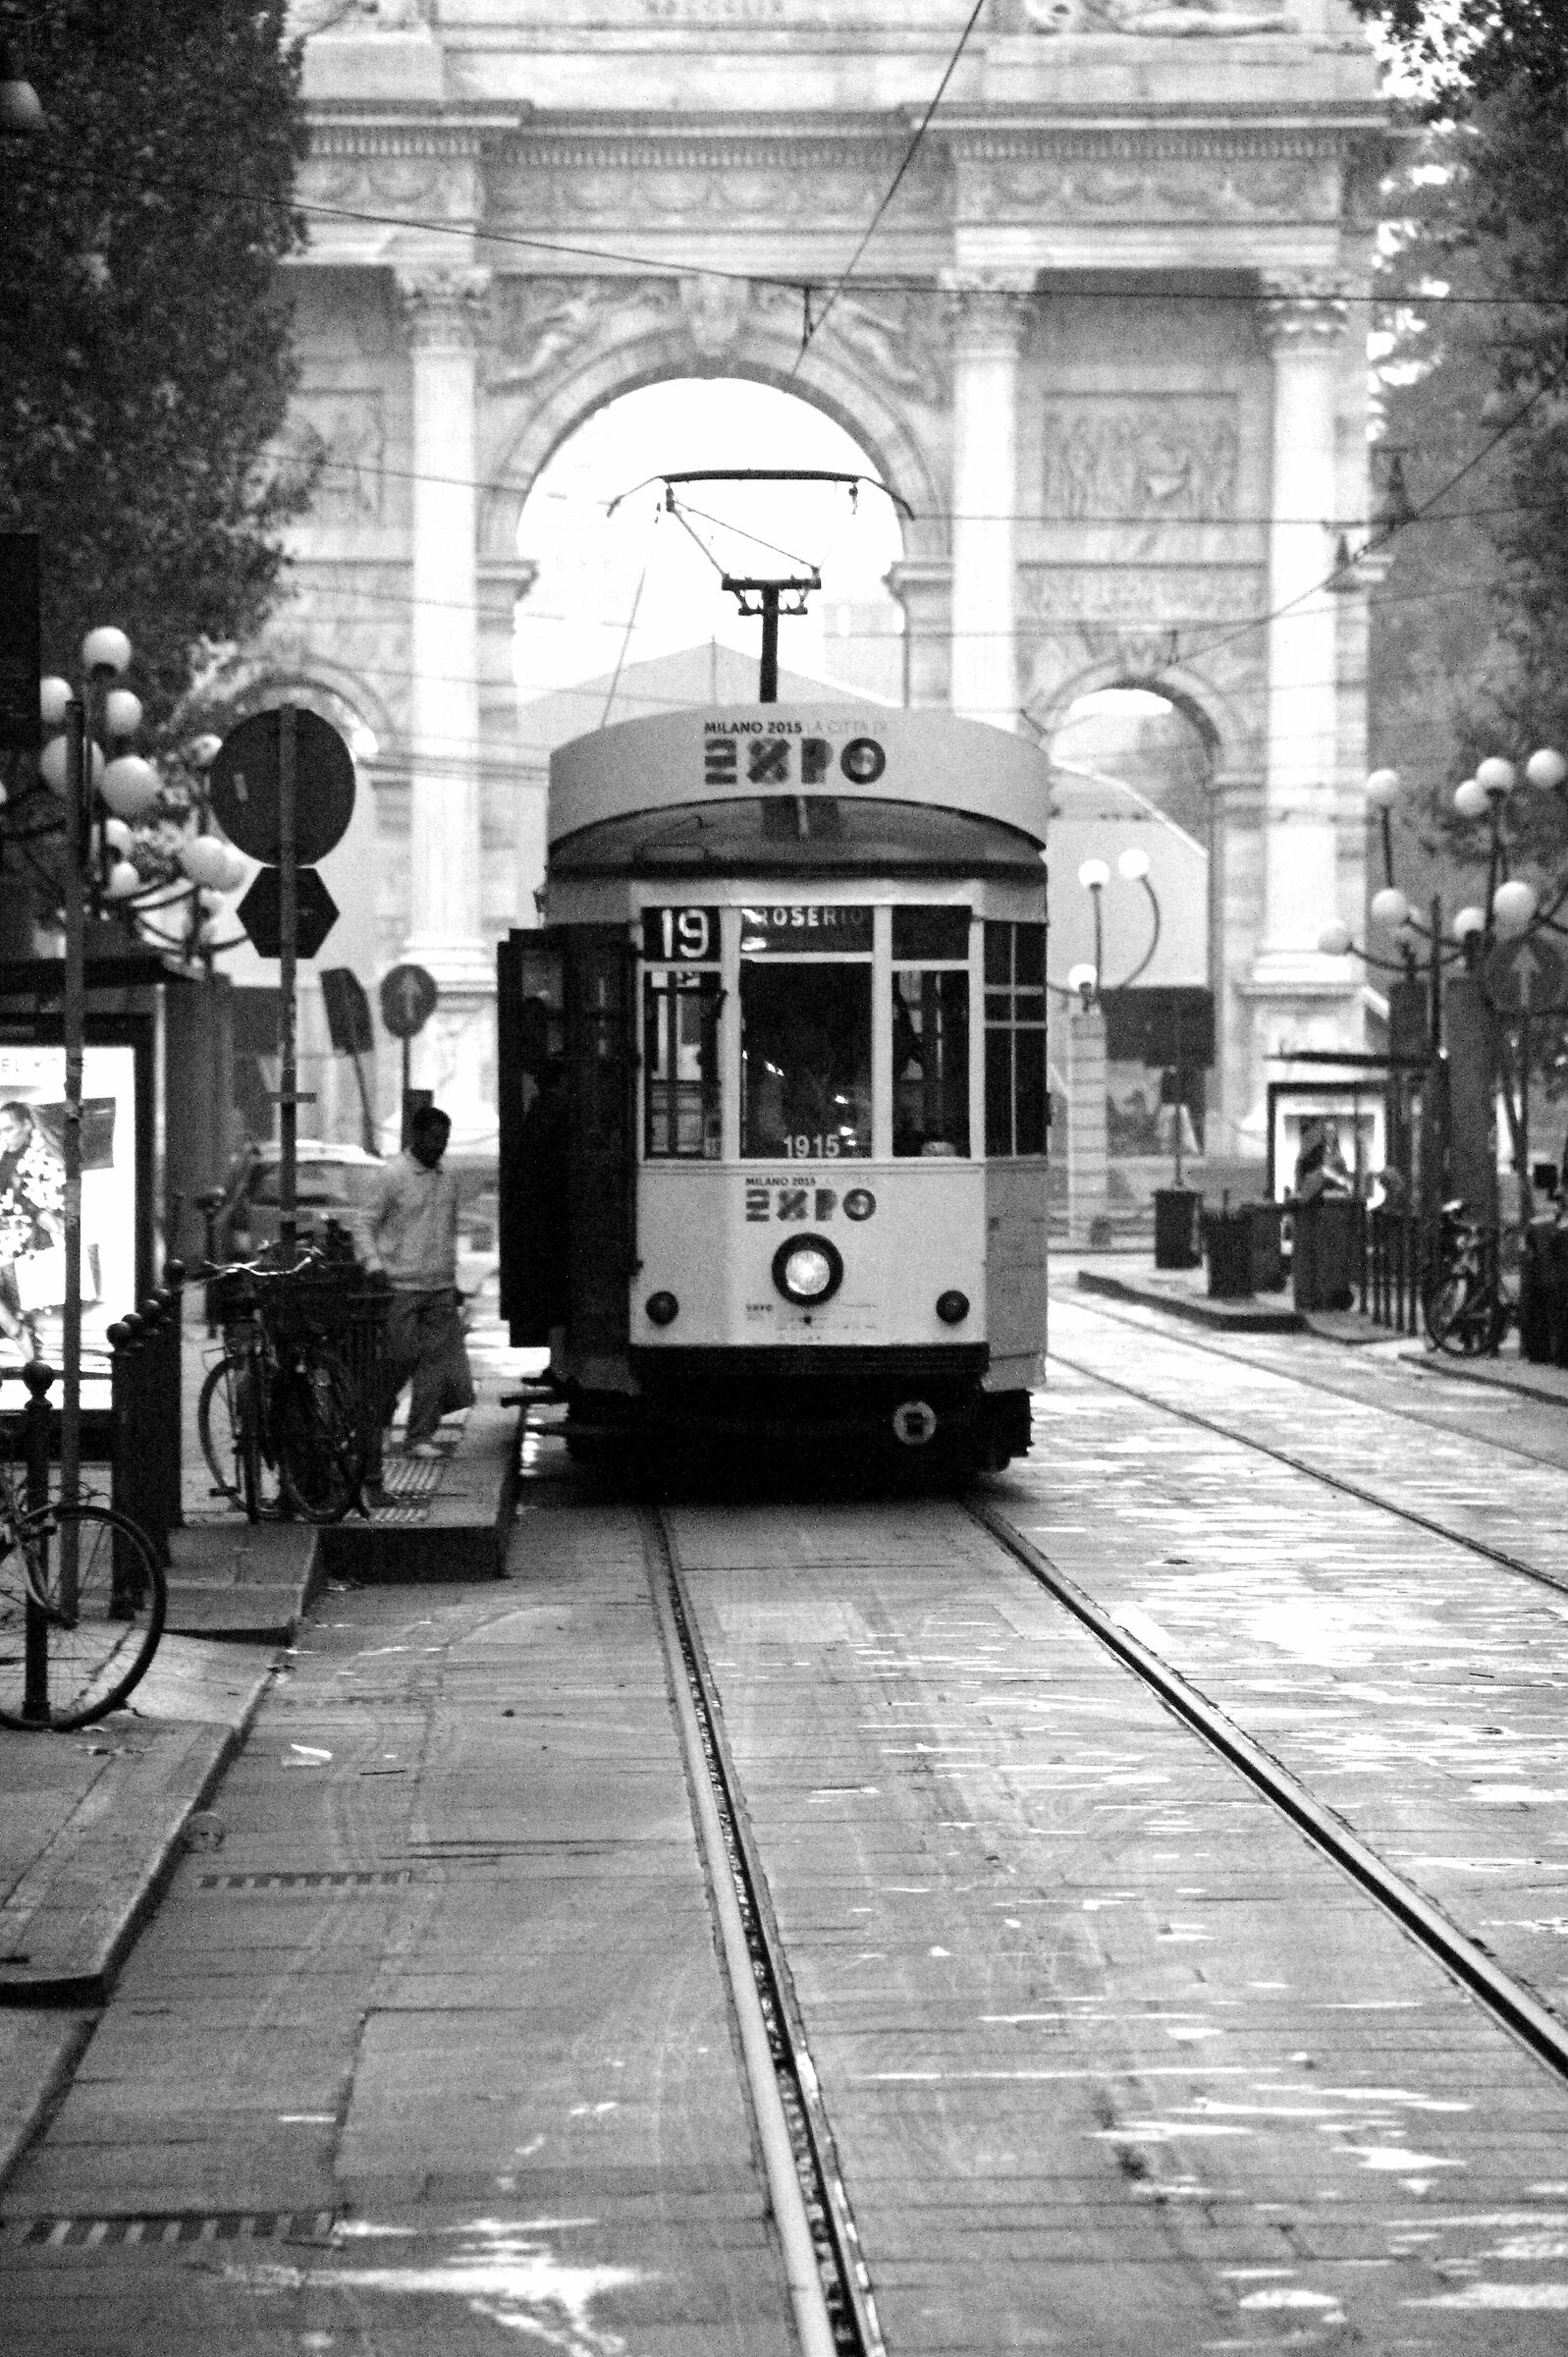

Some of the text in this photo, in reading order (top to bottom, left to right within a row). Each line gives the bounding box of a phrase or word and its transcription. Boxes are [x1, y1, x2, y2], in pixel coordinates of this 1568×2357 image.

[704, 721, 763, 735] MILANO
[768, 721, 802, 735] 2015
[704, 738, 887, 786] EXPO
[662, 908, 709, 959] 19
[784, 1133, 840, 1158] 1915
[745, 1177, 789, 1186] MILANO
[745, 1188, 877, 1222] EXPO
